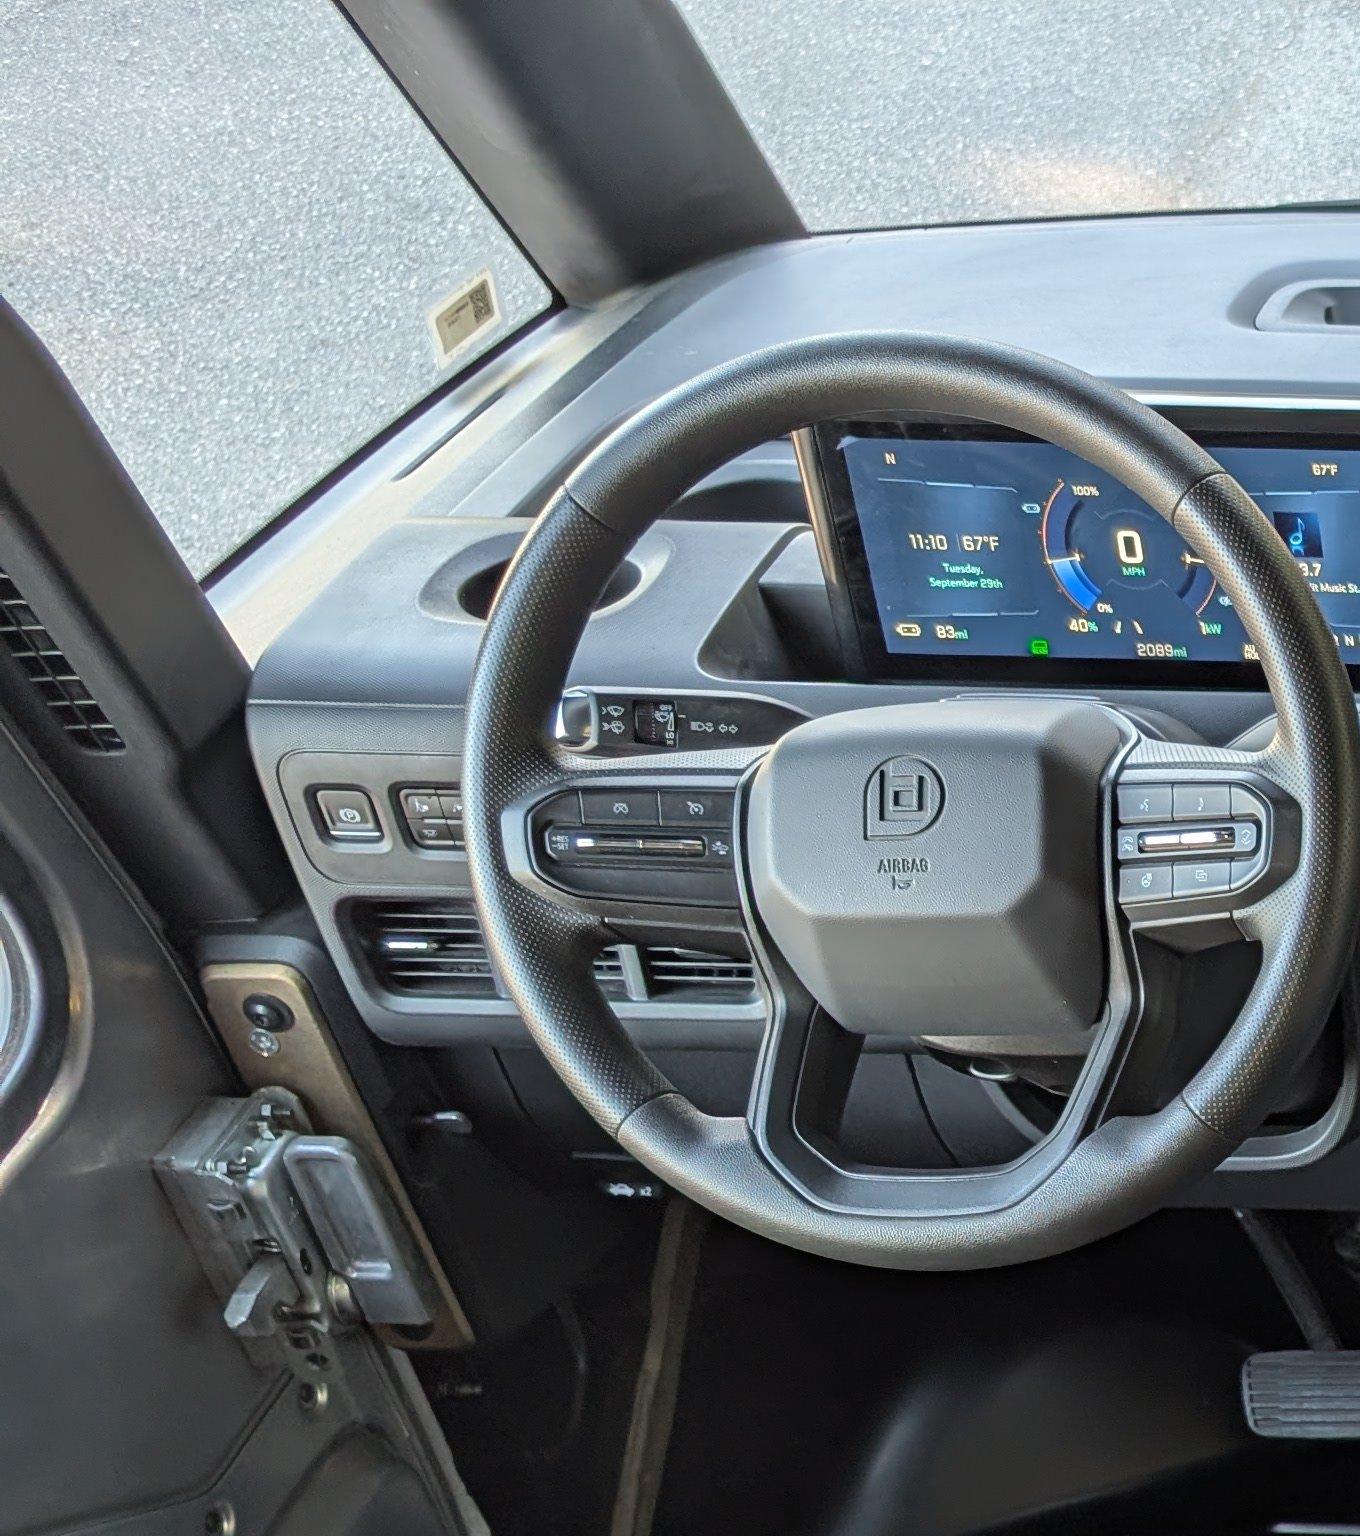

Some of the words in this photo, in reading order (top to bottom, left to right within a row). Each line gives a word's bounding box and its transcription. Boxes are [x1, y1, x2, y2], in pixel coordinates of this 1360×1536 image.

[884, 452, 897, 465] N
[1312, 463, 1339, 476] 67°F
[1071, 485, 1100, 497] 100%
[908, 533, 948, 551] 11:10
[962, 535, 999, 552] 67°F
[1116, 529, 1145, 565] 0
[1121, 567, 1146, 577] MPH
[928, 577, 980, 590] September
[1320, 582, 1348, 593] Music
[1096, 603, 1114, 614] 0%
[1069, 619, 1099, 633] 40%
[1343, 633, 1355, 647] N
[877, 857, 929, 874] AIRBAG
